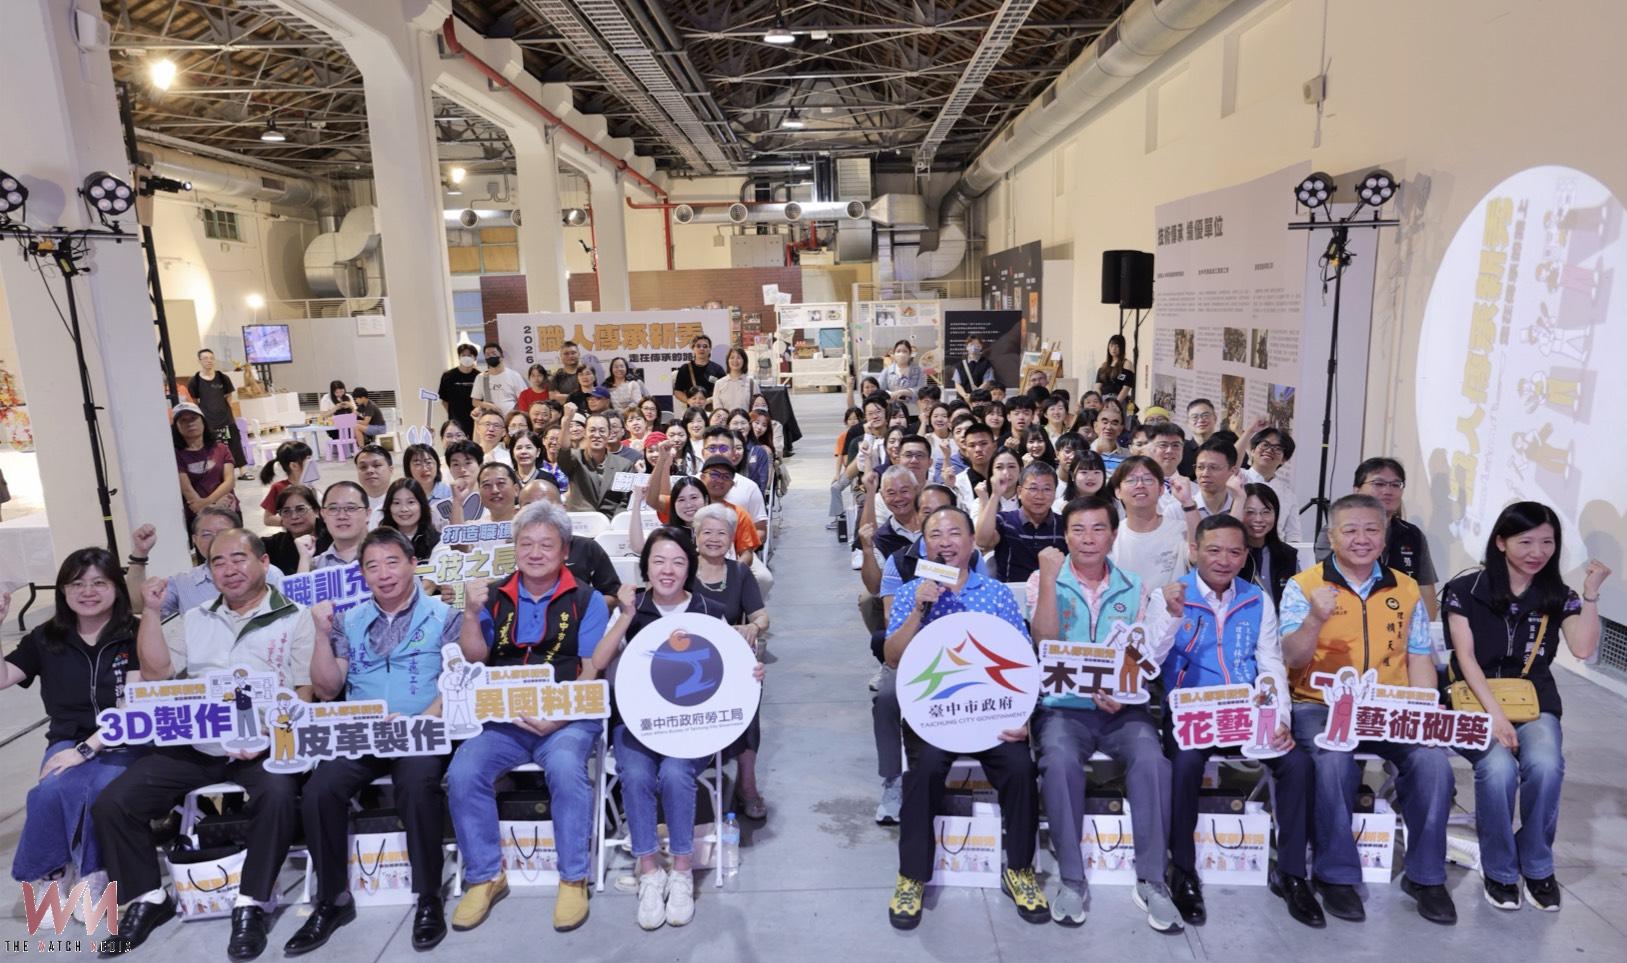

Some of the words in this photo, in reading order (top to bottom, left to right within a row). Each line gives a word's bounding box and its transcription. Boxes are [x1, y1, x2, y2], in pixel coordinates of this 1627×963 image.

[523, 326, 534, 364] 2026
[629, 352, 696, 363] 走在傳承的路
[414, 546, 518, 584] 一技之長
[1041, 661, 1115, 696] 木工
[475, 683, 606, 720] 異國料理
[640, 708, 744, 731] 臺中市政府勞工局
[920, 719, 957, 728] TAICHUNG
[976, 711, 1026, 721] GOVERNMENT
[929, 696, 1012, 717] 臺中市政府
[99, 702, 233, 742] 3D製作
[298, 718, 448, 757] 皮革製作
[1177, 707, 1253, 746] 花藝
[1355, 705, 1490, 746] 藝術砌築
